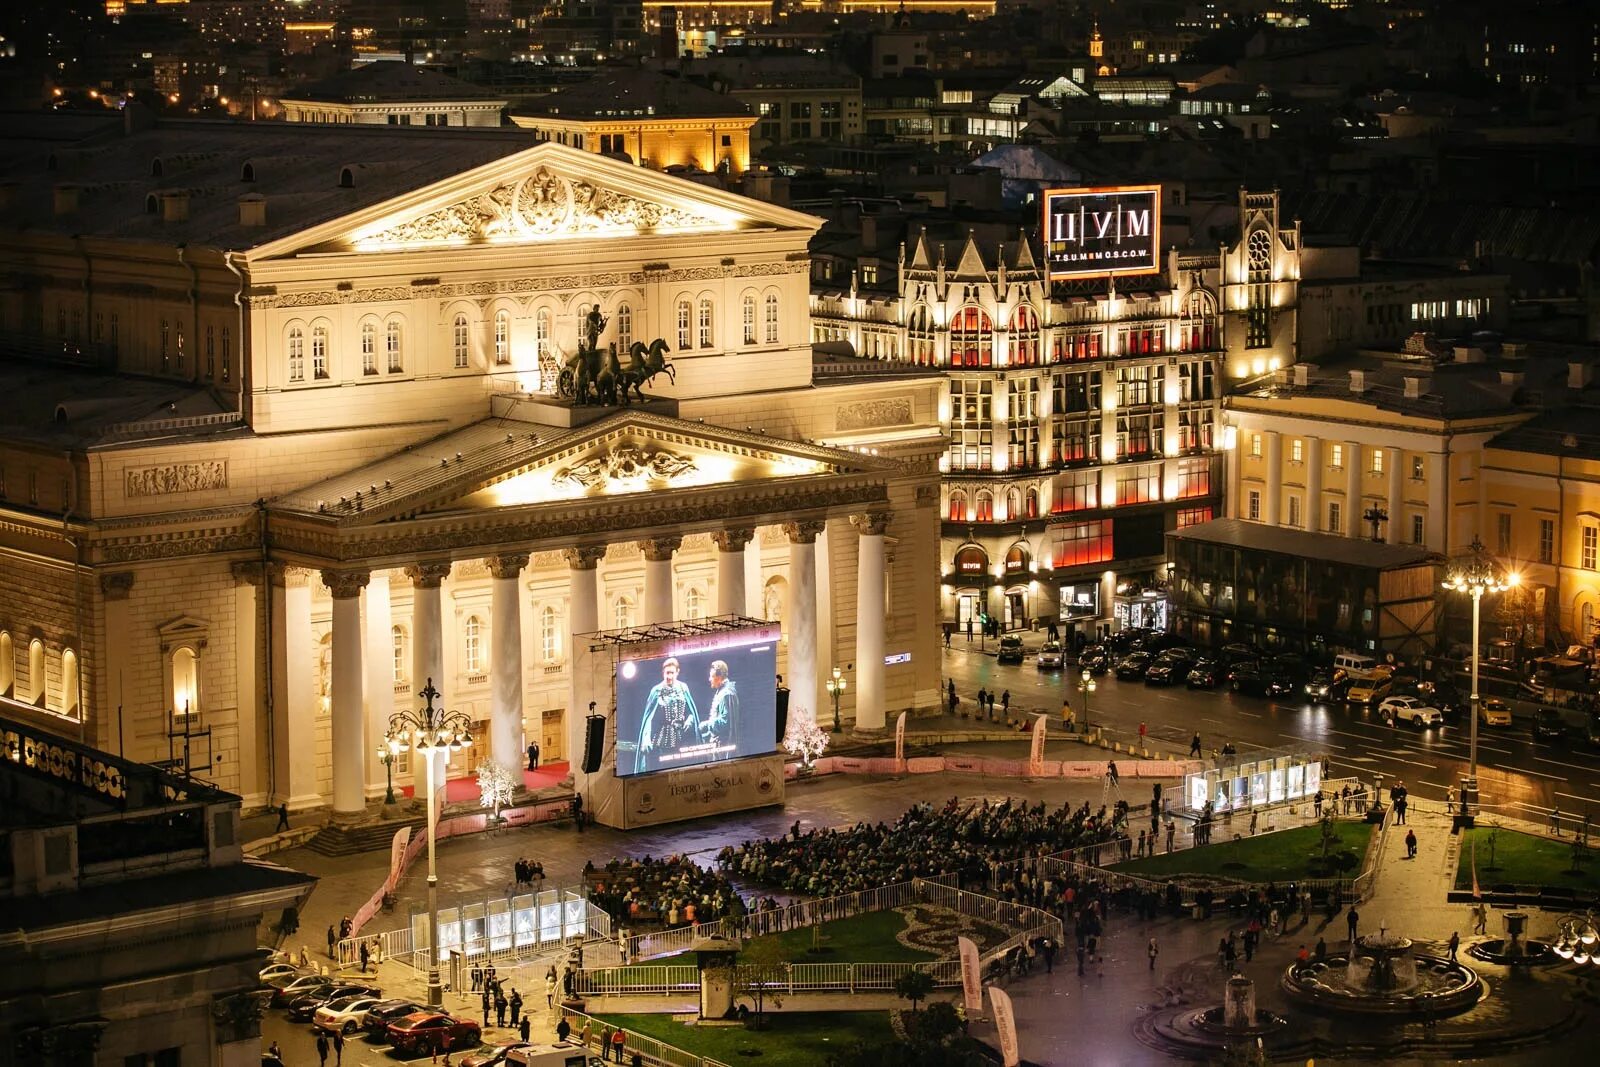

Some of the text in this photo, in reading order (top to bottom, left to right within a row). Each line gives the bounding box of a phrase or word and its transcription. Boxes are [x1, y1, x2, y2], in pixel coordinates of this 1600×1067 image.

[1095, 249, 1147, 259] MOSCOW
[669, 783, 701, 796] TEATRO
[713, 777, 743, 789] SCALA
